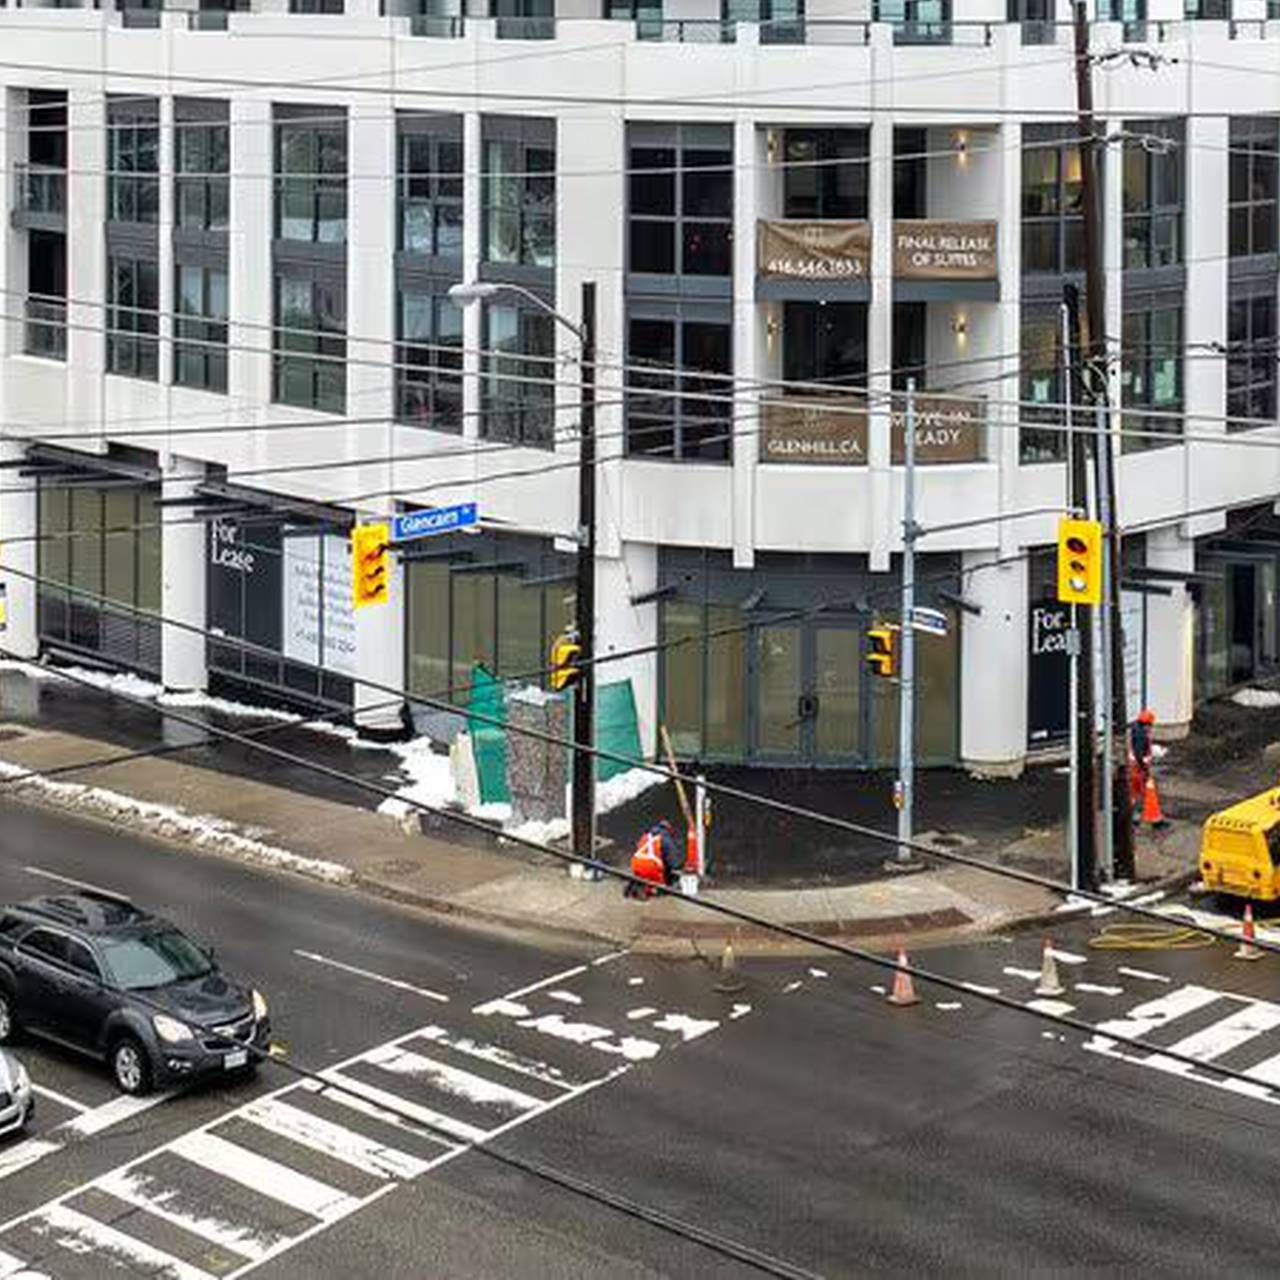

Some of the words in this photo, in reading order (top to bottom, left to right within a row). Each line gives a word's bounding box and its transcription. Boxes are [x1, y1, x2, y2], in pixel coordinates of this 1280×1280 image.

[897, 235, 936, 250] FINAL
[940, 236, 991, 251] RELEASE
[912, 252, 931, 266] OF
[934, 253, 977, 267] SUITES
[211, 518, 237, 544] For
[401, 511, 458, 534] Glencairn
[211, 540, 255, 572] Lease
[1033, 608, 1064, 630] For
[1033, 630, 1067, 654] Lea
